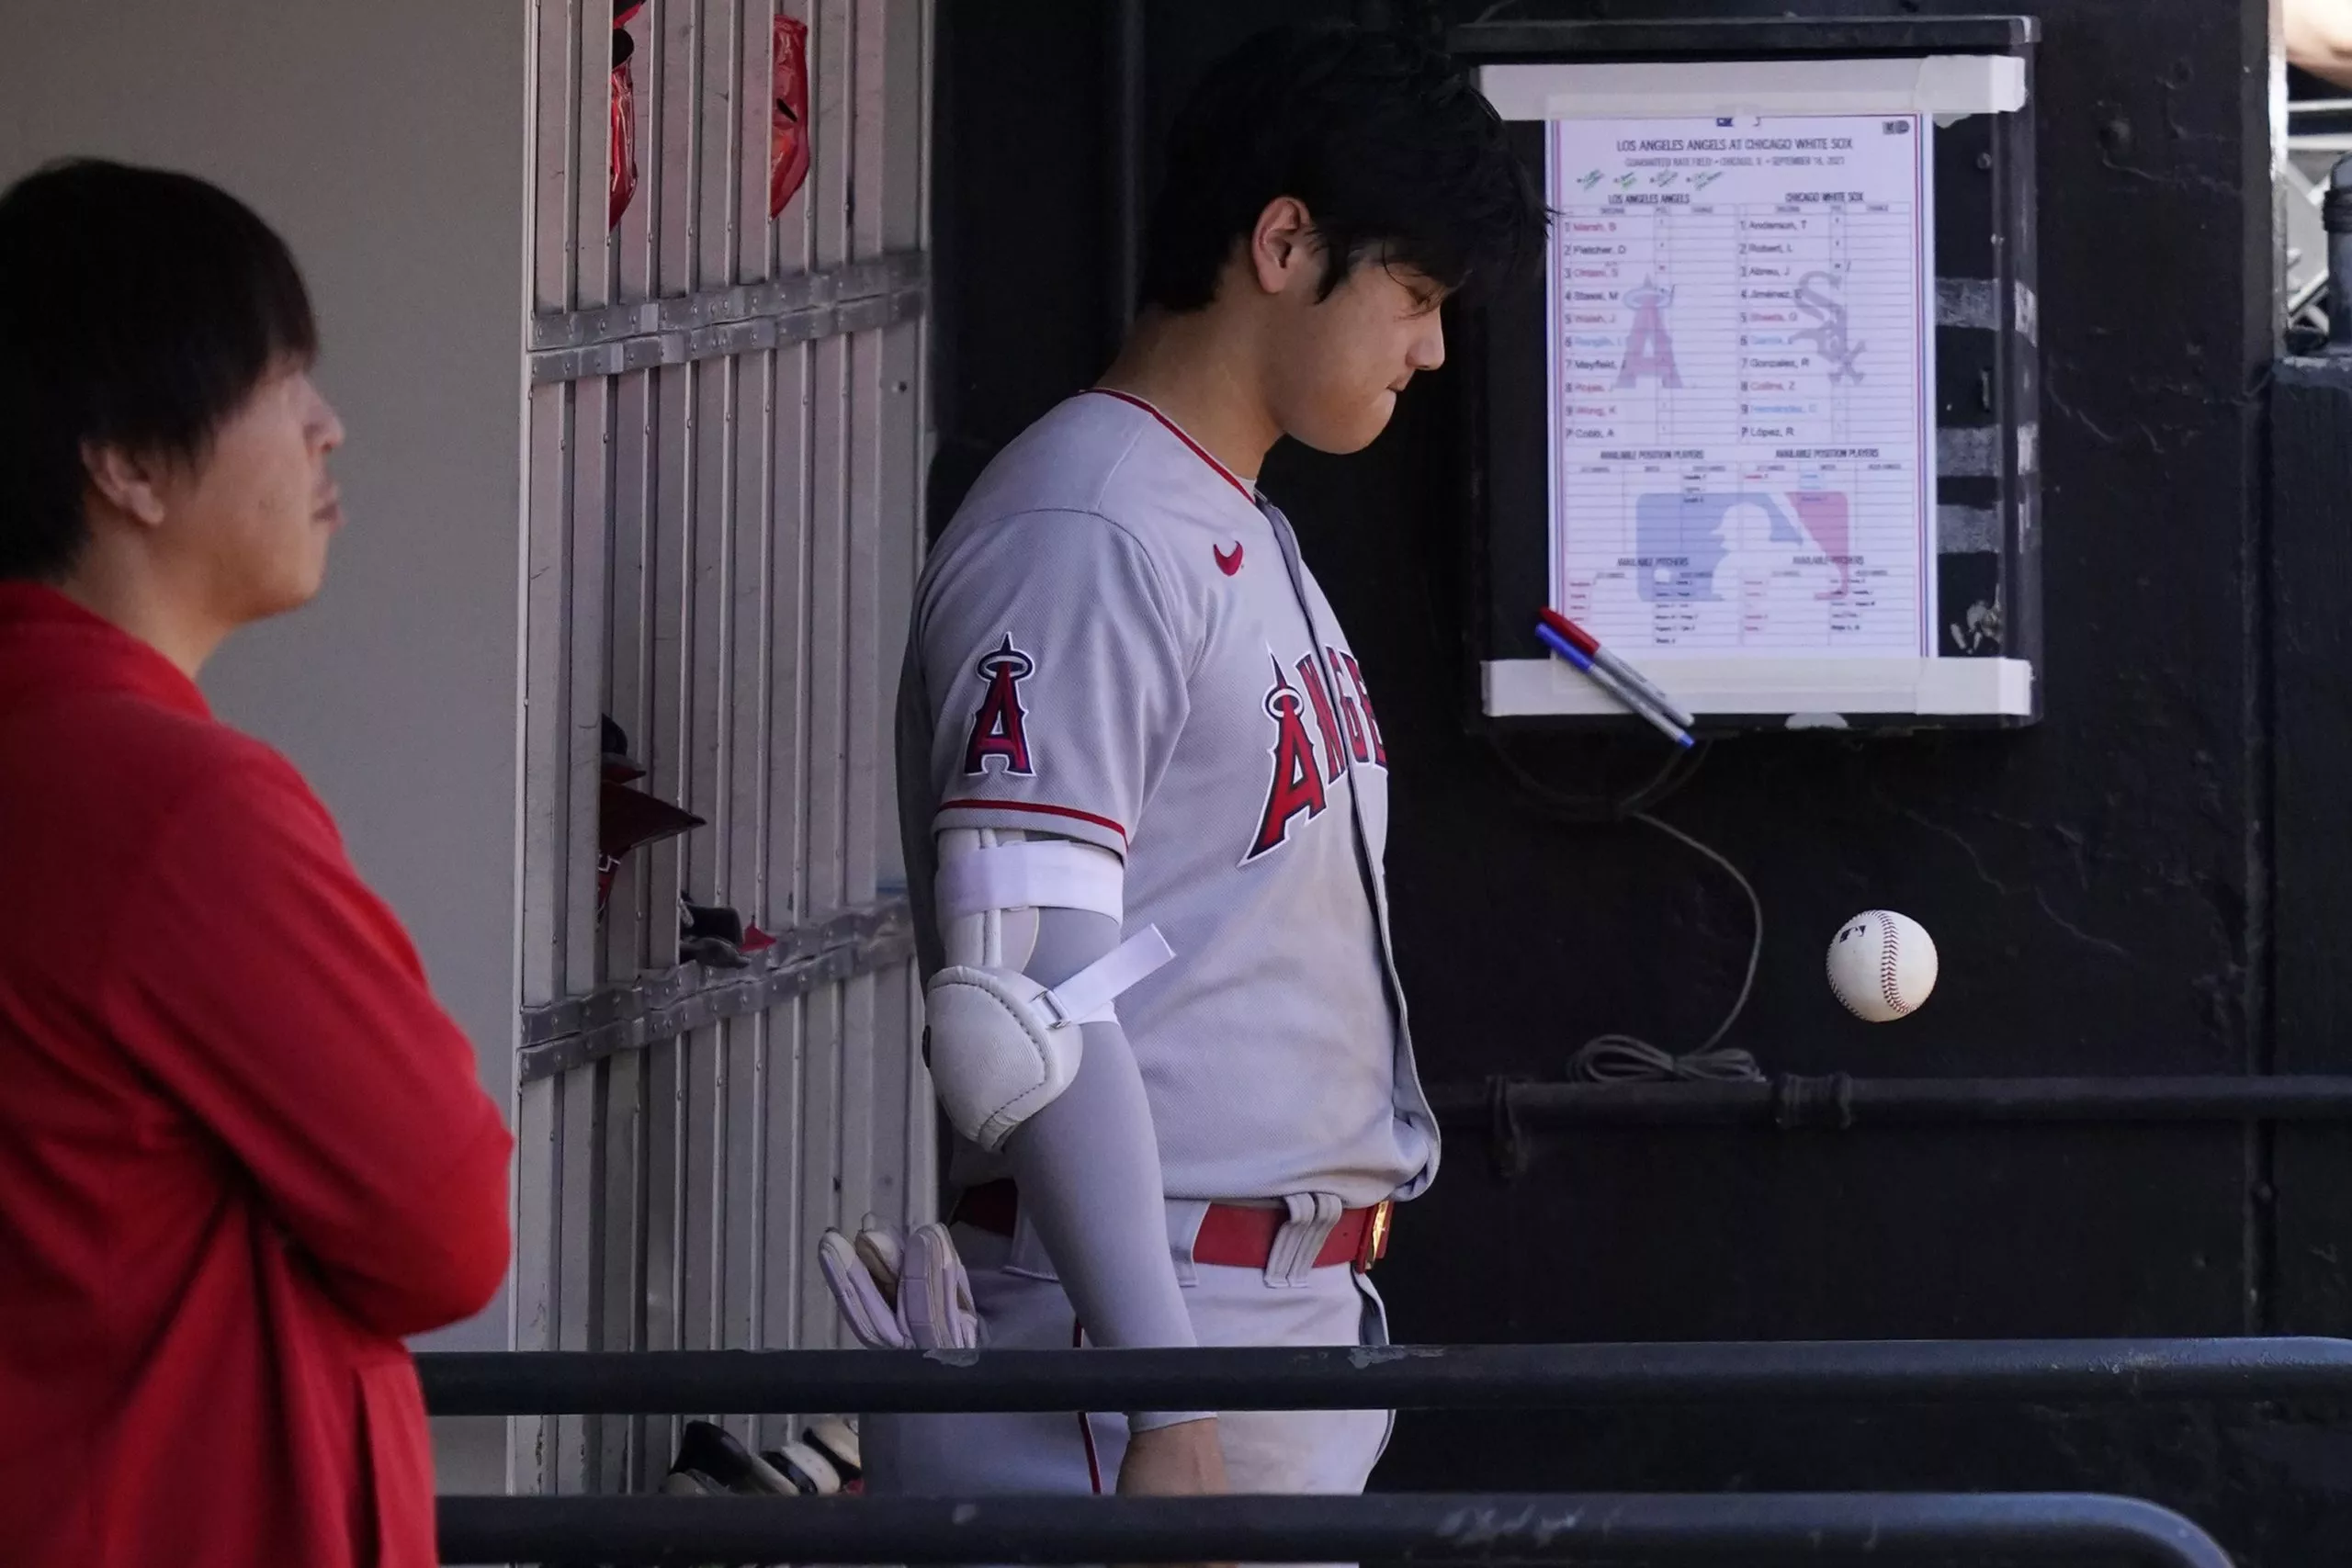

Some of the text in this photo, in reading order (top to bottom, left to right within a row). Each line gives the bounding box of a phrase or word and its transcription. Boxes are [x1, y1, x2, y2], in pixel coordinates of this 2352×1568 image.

[1617, 138, 1853, 152] LOS ANGELES ANGELS AT CHICAGO WHITE SOX
[1608, 194, 1690, 204] LOS ANGELES ANGELS
[1785, 191, 1863, 202] CHICAGO WHITE SOX
[1801, 220, 1807, 229] T
[1564, 244, 1571, 255] 2
[1618, 245, 1626, 254] D
[1739, 243, 1747, 254] 2
[1565, 267, 1571, 278] 3
[1566, 360, 1571, 369] 7
[965, 631, 1036, 777] A
